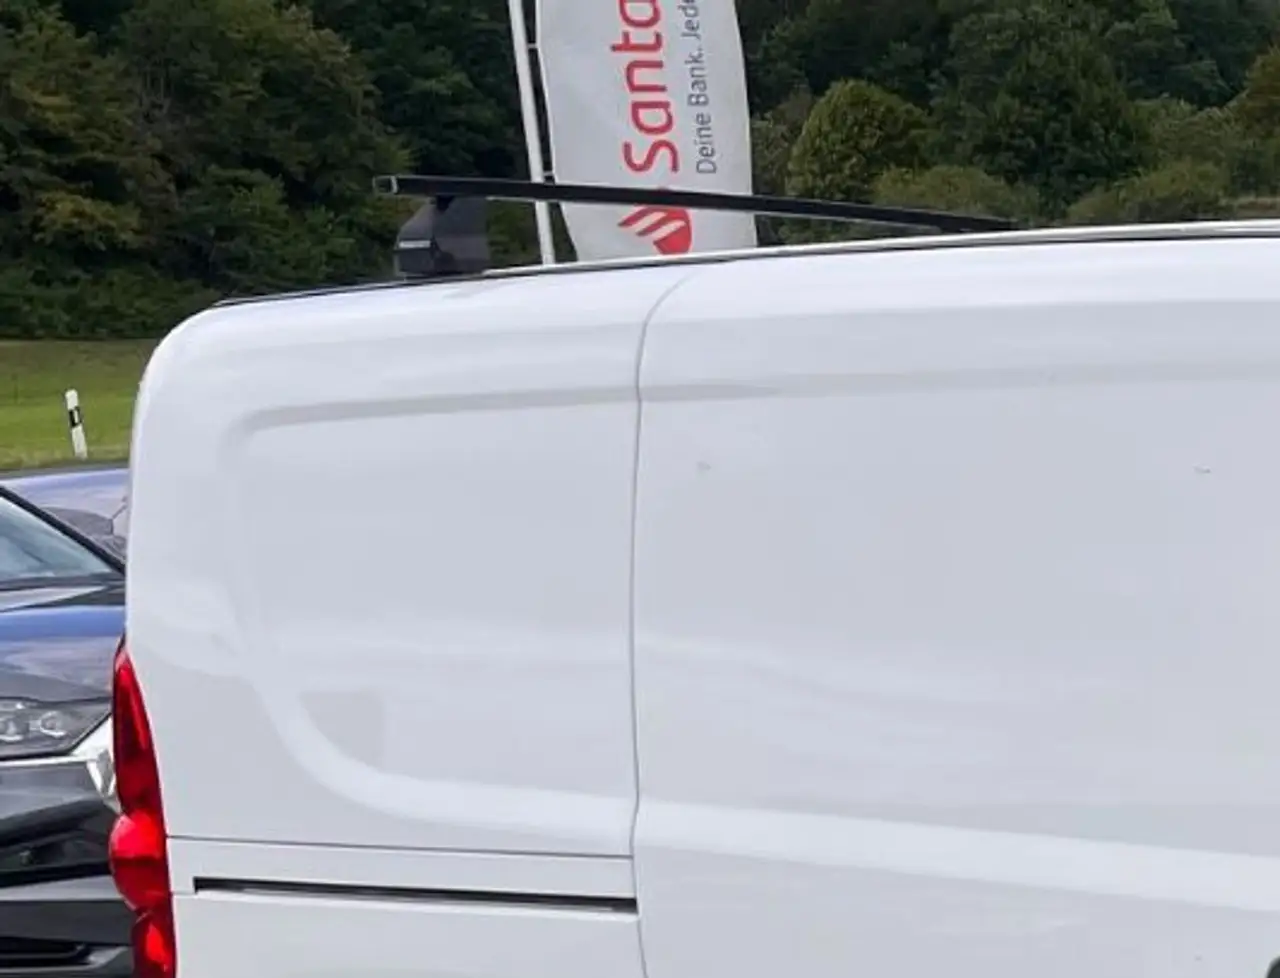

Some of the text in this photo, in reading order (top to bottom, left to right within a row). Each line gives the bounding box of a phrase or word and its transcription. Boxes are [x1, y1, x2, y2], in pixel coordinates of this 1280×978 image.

[677, 0, 717, 174] Deine Bank. Jed
